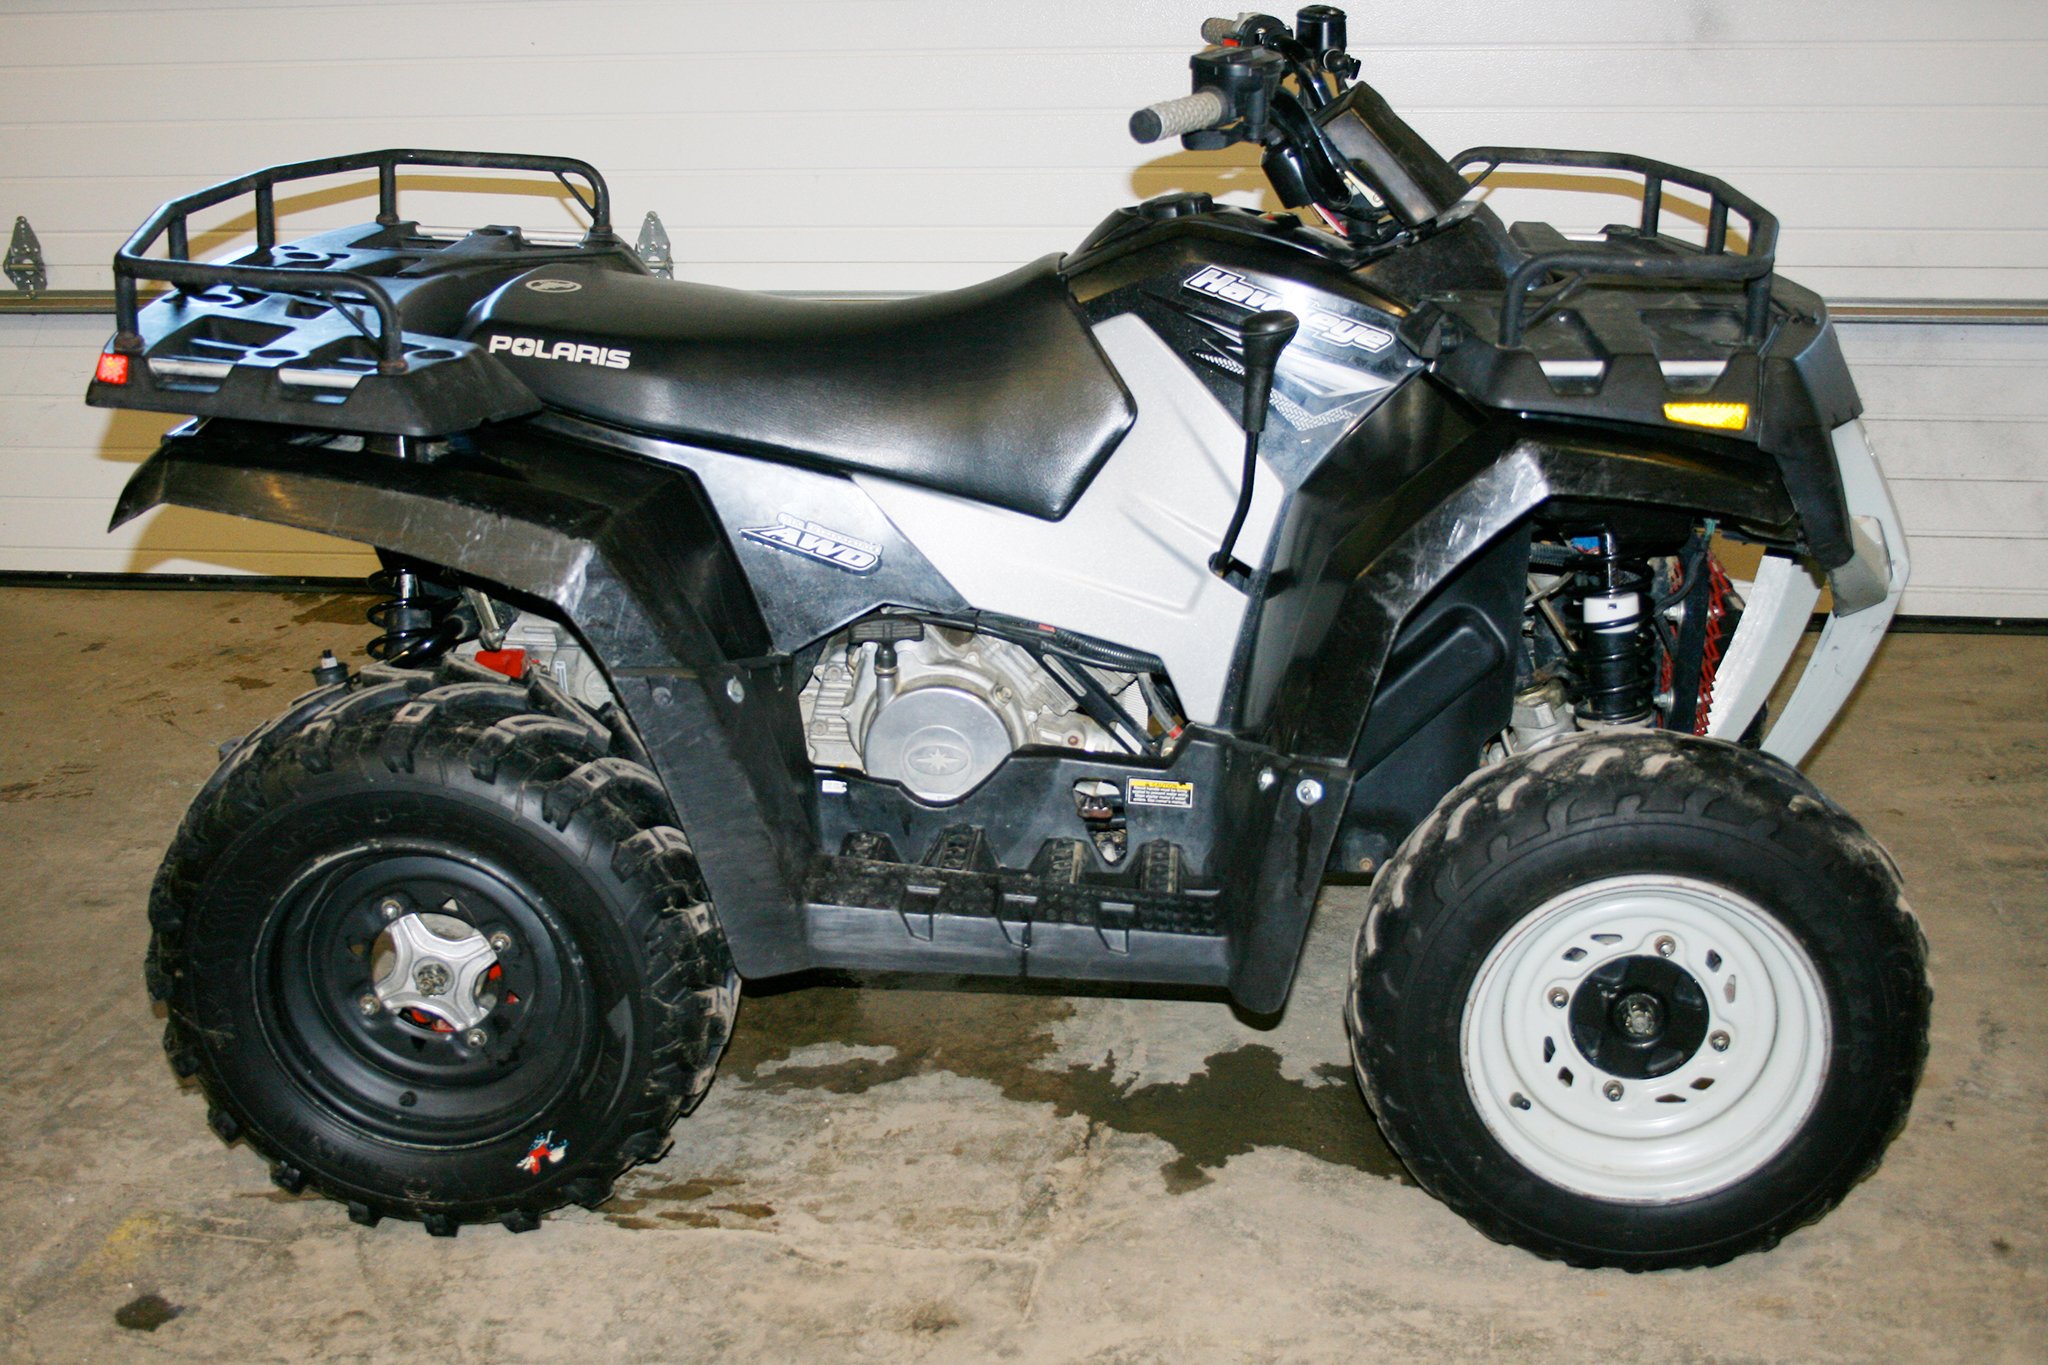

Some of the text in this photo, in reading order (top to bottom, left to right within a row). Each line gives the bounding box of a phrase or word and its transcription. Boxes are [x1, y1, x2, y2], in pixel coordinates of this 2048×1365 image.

[1187, 267, 1394, 352] Haweye
[488, 335, 631, 370] POLARIS
[755, 526, 877, 569] AWD
